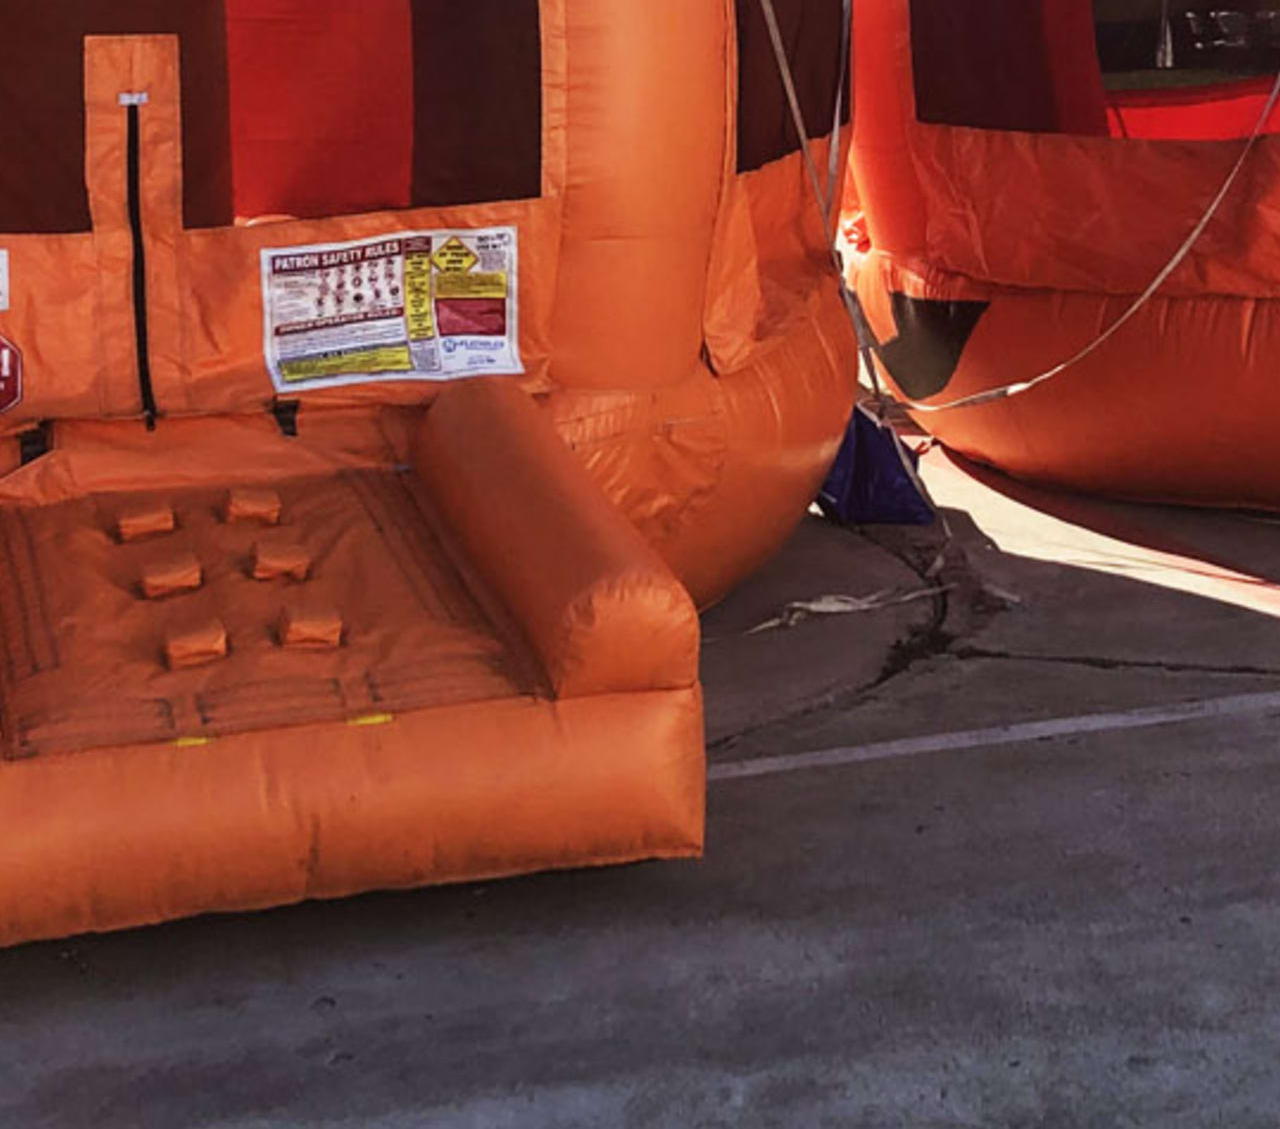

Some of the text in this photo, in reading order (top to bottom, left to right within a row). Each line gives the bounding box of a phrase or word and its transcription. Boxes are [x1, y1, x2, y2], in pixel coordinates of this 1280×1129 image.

[275, 254, 319, 270] PATRON
[321, 250, 362, 266] SAFETY
[365, 241, 399, 258] RULES
